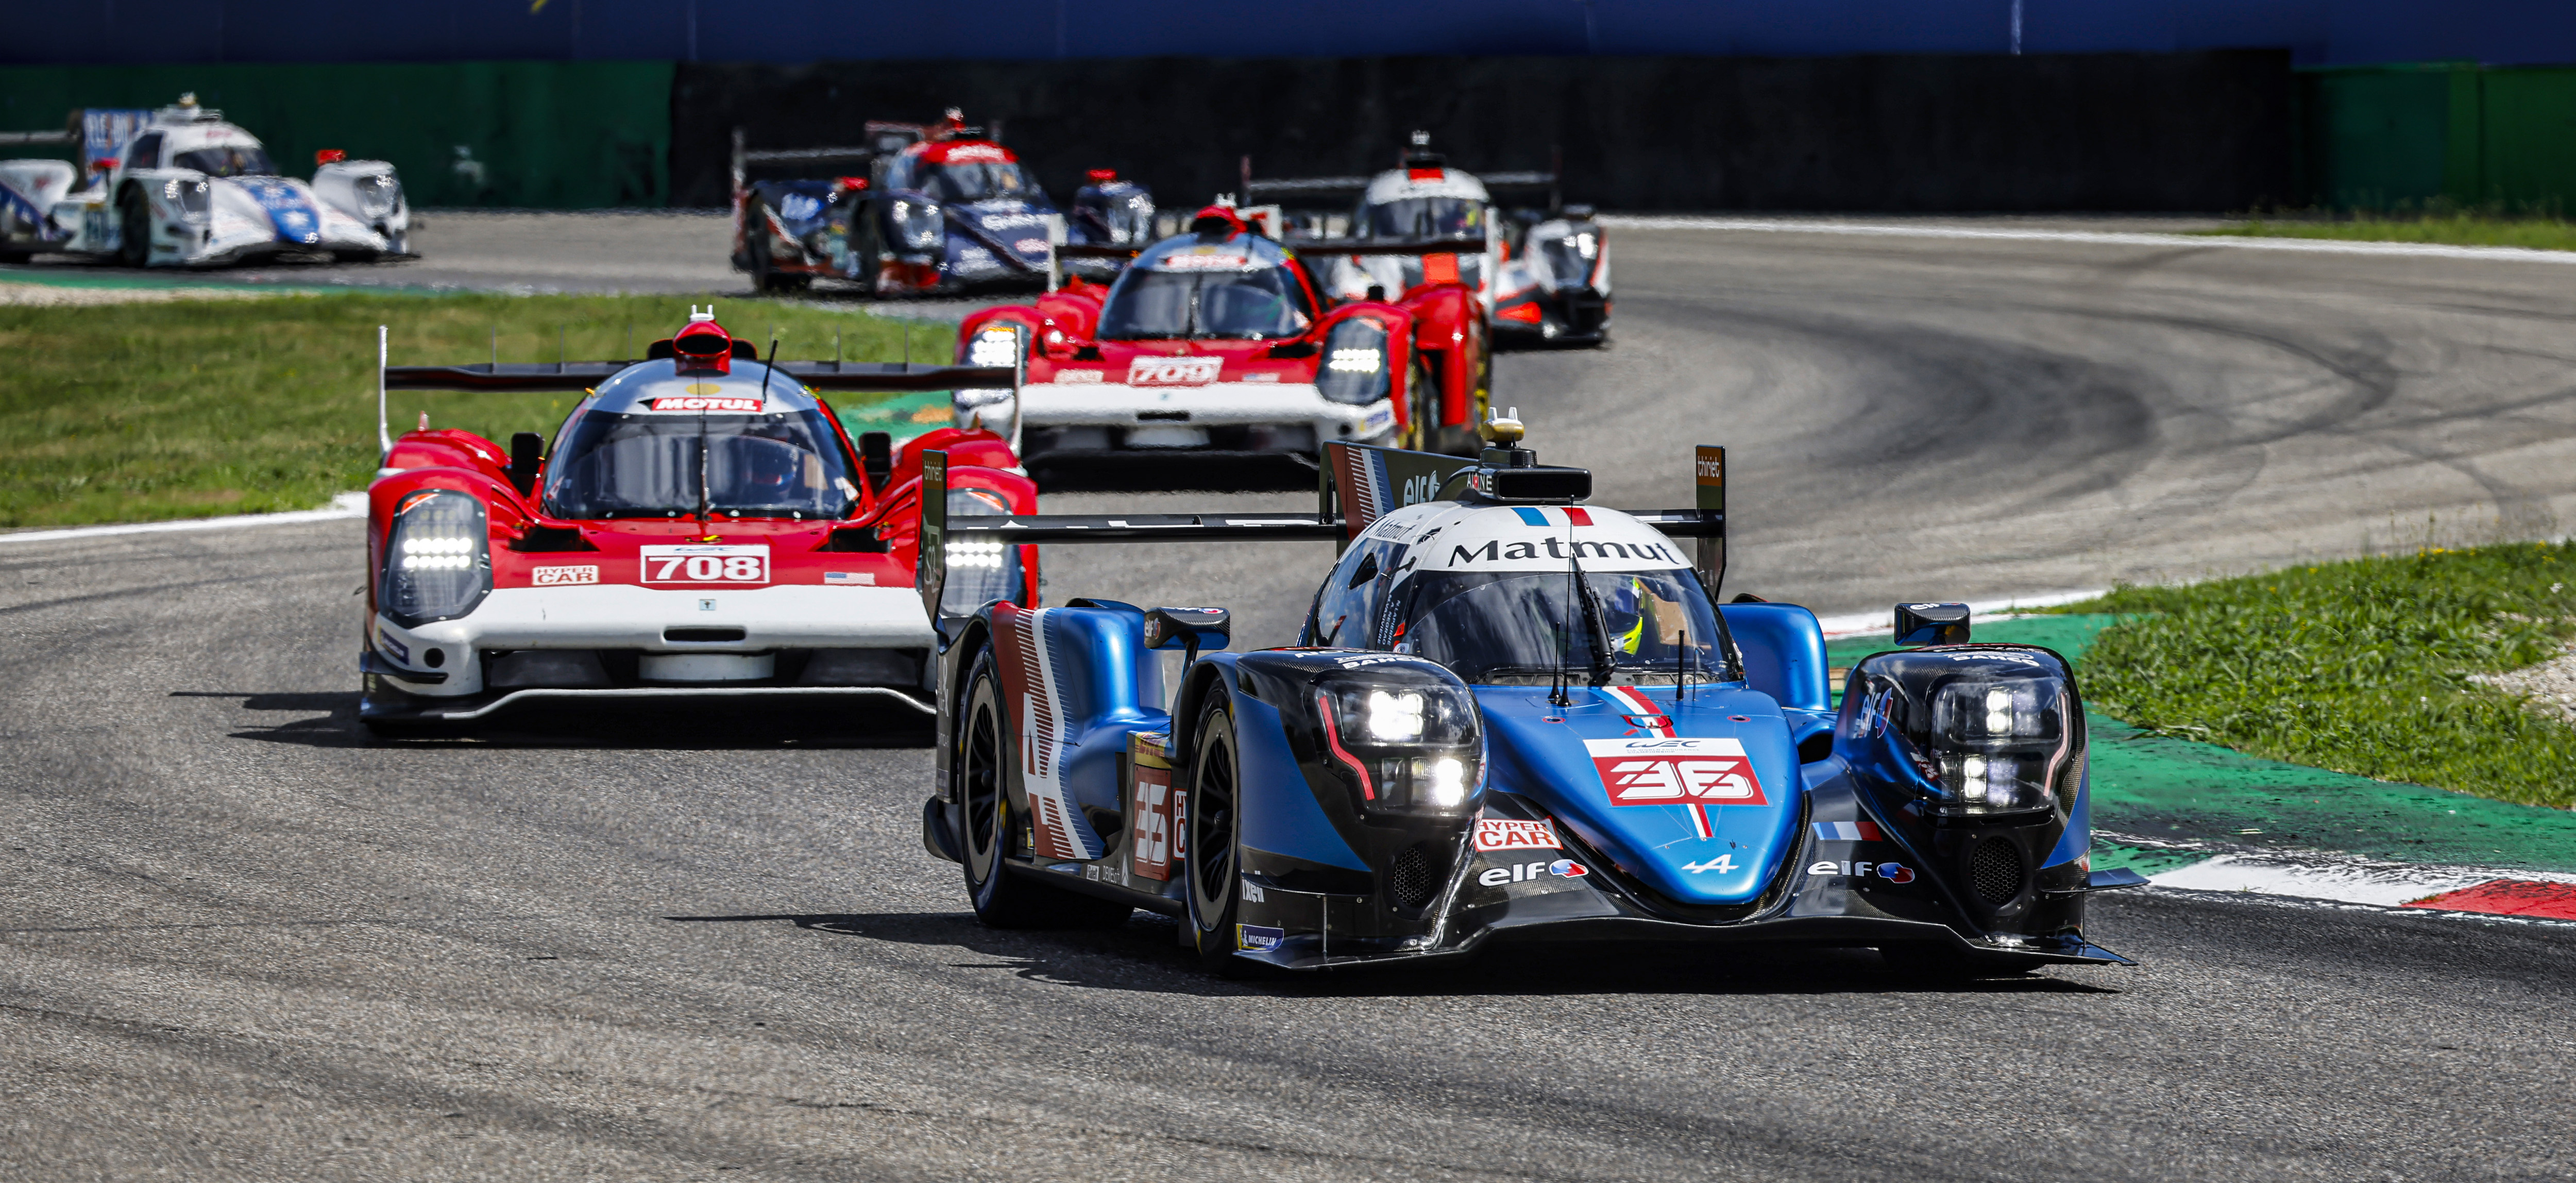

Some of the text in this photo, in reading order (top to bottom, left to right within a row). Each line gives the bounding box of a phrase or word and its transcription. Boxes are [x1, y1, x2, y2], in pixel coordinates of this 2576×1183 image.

[1134, 365, 1212, 382] 709
[656, 398, 757, 410] MOTUL
[1698, 455, 1719, 478] thiriet
[1370, 519, 1417, 540] Matmut
[1448, 537, 1680, 567] Matmut
[537, 566, 593, 574] HYPER
[648, 556, 761, 580] 708
[537, 573, 593, 584] CAR
[1145, 620, 1154, 637] elf
[1343, 657, 1429, 669] BAHCO
[1953, 655, 2040, 667] BAHCO
[1609, 760, 1754, 800] 36
[1136, 782, 1167, 866] 36
[1478, 821, 1549, 832] HYPER
[1479, 831, 1555, 847] CAR
[1479, 861, 1546, 887] elf
[1807, 860, 1872, 876] elf
[1248, 935, 1277, 946] MICHELIN
